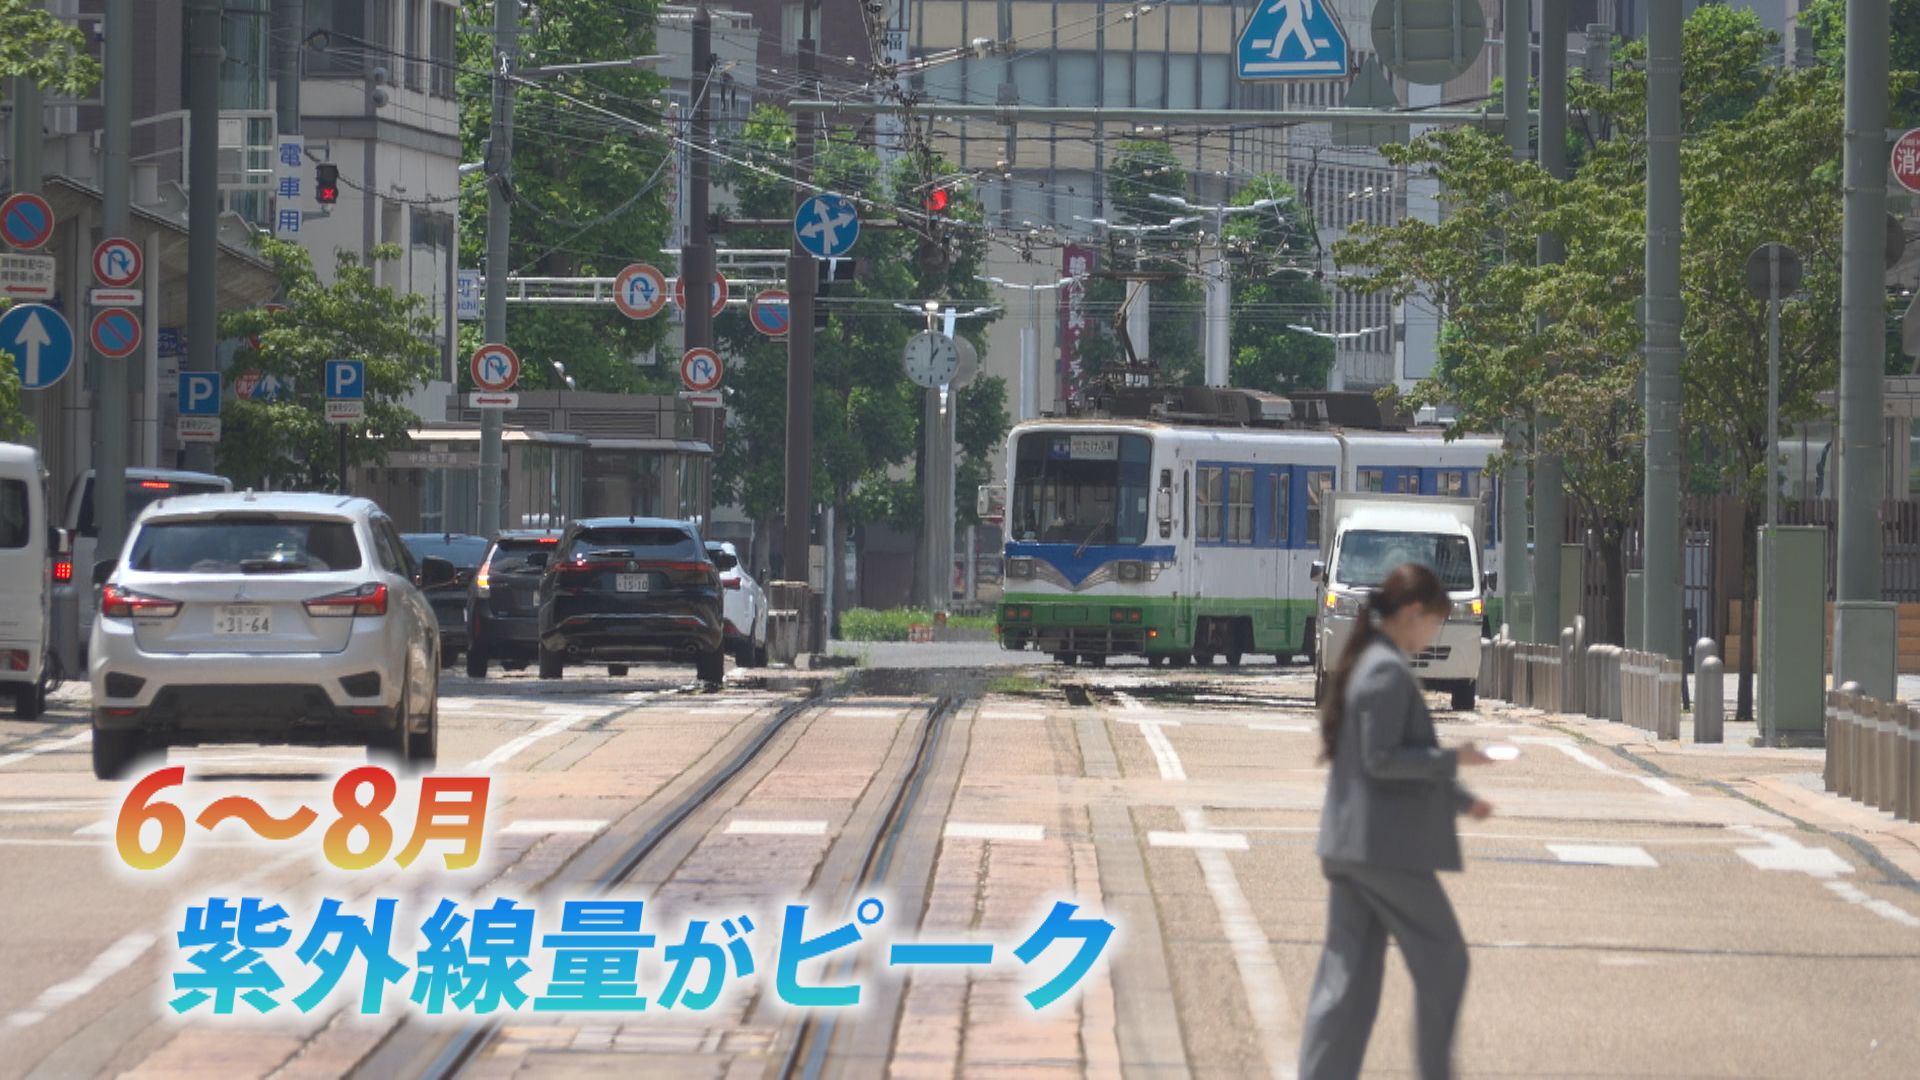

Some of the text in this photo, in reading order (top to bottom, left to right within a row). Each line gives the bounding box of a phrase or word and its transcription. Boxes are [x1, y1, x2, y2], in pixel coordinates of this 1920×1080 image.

[1896, 147, 1920, 175] 消
[278, 143, 302, 232] 電車用
[188, 377, 213, 410] P
[335, 364, 356, 395] P
[225, 616, 269, 633] 31-64
